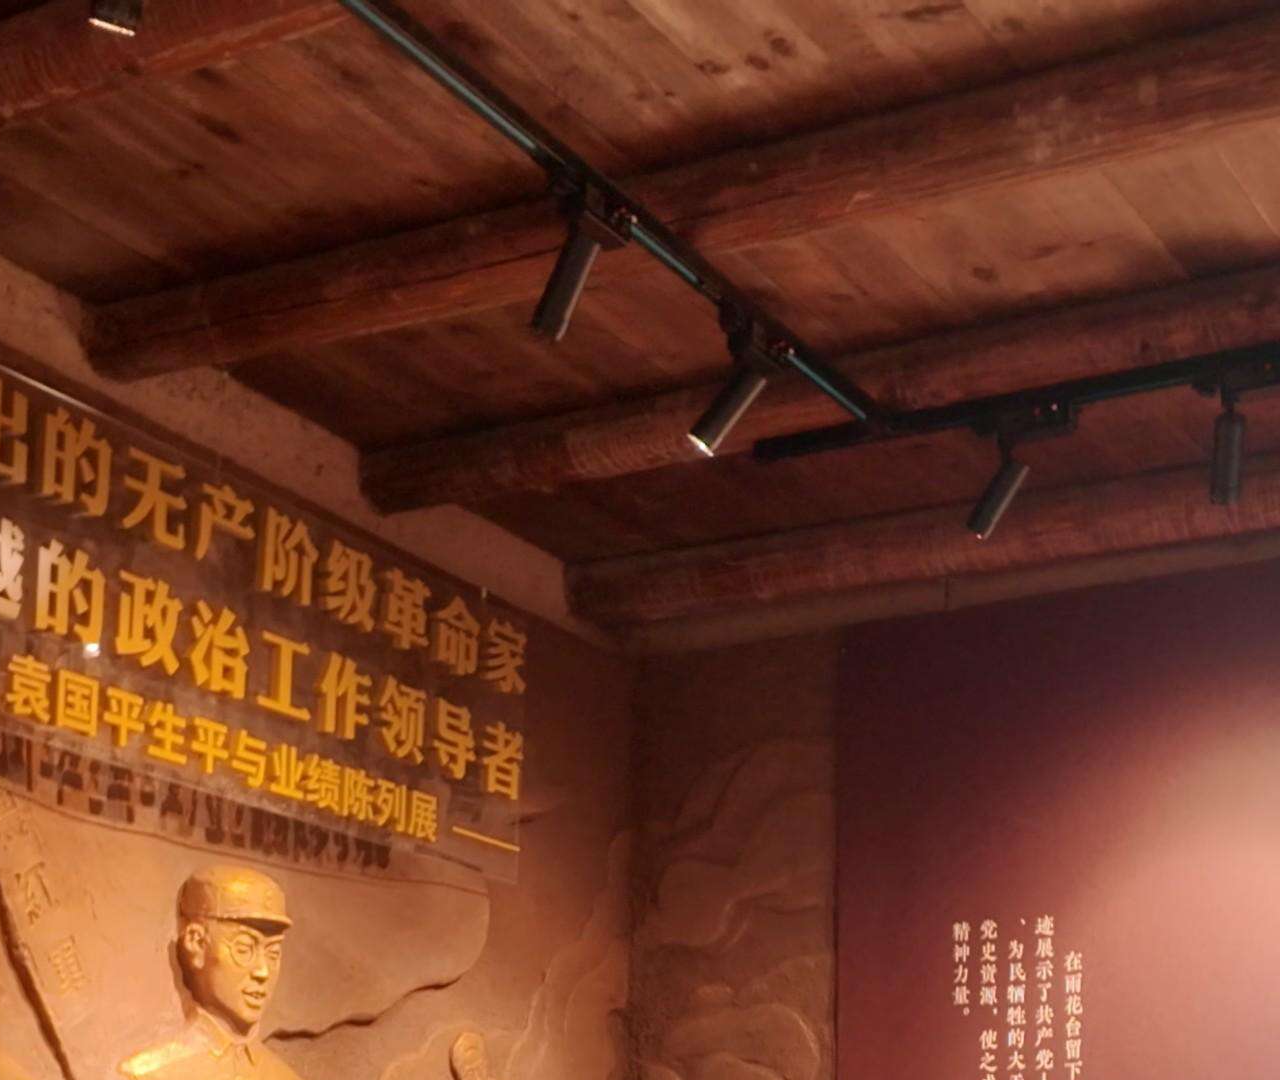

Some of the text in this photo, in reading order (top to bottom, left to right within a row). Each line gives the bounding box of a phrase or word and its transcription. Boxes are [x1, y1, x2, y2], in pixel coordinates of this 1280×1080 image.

[6, 653, 439, 843] 袁国平生平与业绩陈列展
